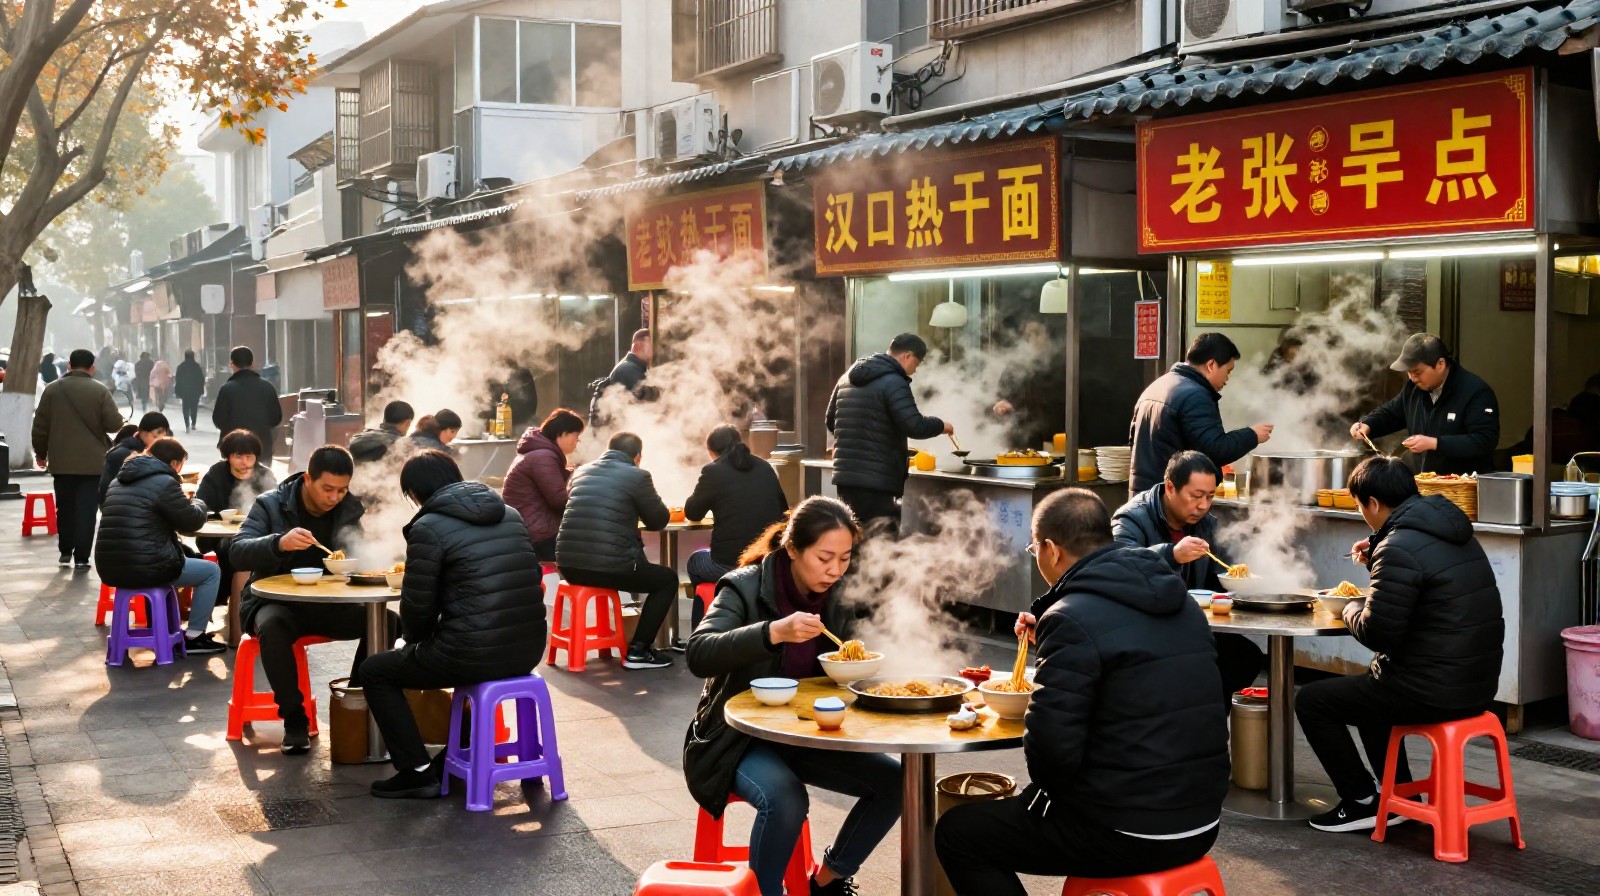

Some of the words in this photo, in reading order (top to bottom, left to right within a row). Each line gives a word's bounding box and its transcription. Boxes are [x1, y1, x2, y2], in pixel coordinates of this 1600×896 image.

[825, 164, 1043, 254] 汉口热干面
